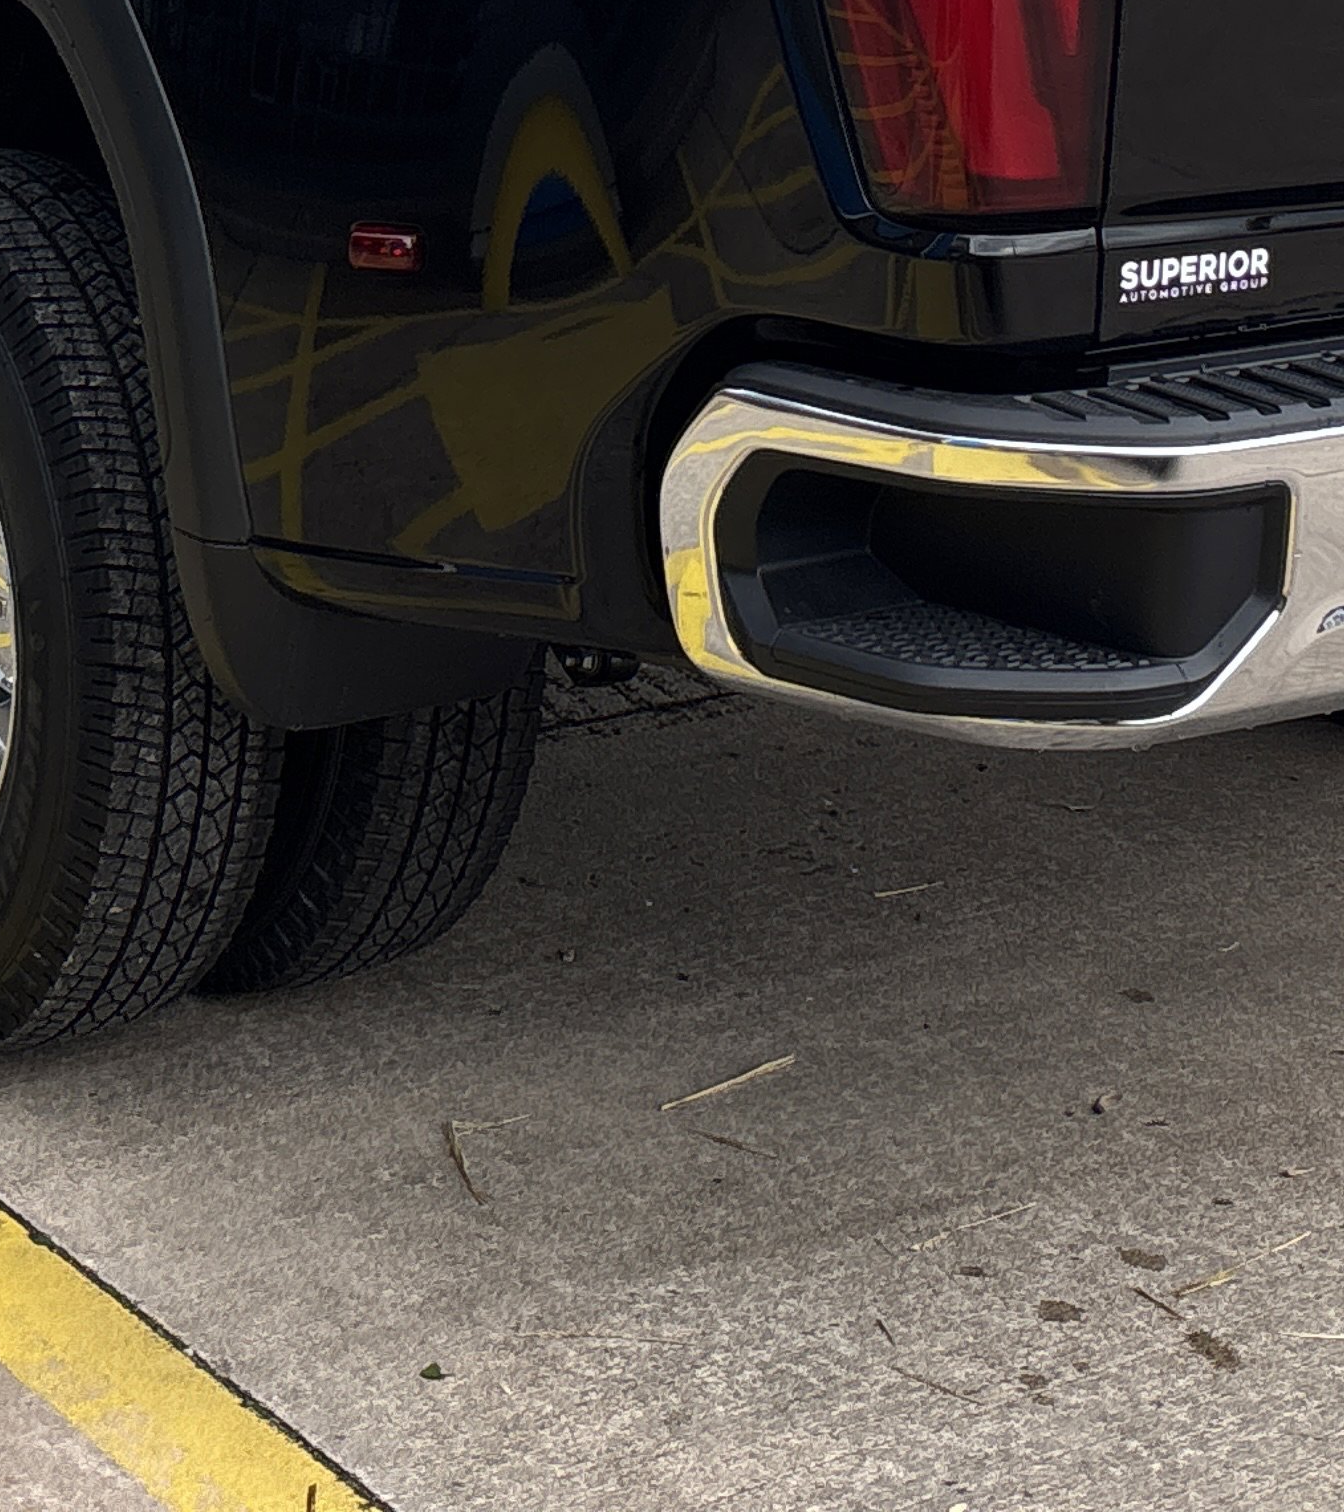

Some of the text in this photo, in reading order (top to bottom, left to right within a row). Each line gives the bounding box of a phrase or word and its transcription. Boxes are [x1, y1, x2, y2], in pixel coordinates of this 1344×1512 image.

[1120, 248, 1269, 290] SUPERIOR
[1119, 277, 1269, 303] AUTOMOTIVE GROUP
